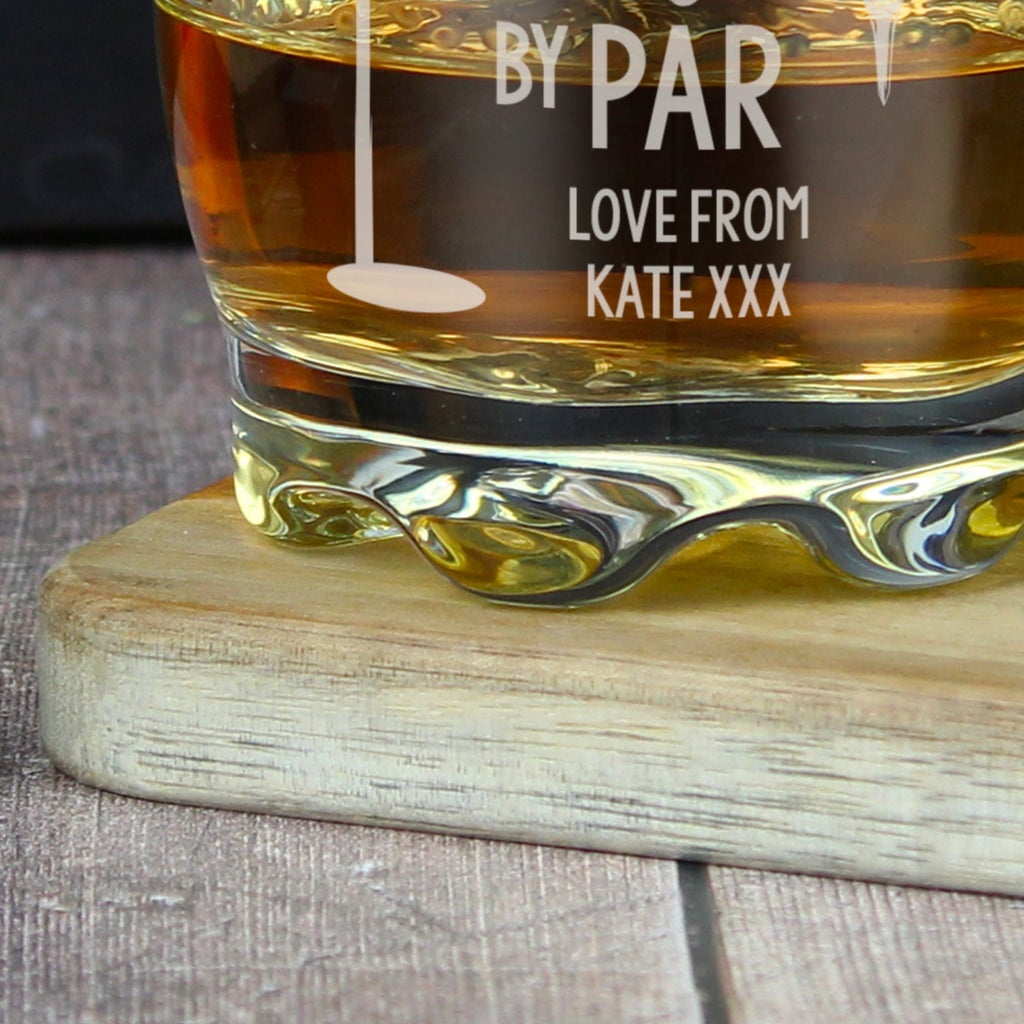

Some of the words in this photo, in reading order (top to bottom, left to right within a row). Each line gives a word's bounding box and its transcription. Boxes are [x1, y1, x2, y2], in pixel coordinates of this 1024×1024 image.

[495, 20, 568, 109] BY
[591, 24, 783, 153] PAR
[568, 187, 678, 244] LOVE
[690, 185, 810, 244] FROM
[586, 262, 694, 320] KATE
[708, 262, 793, 320] XXX
